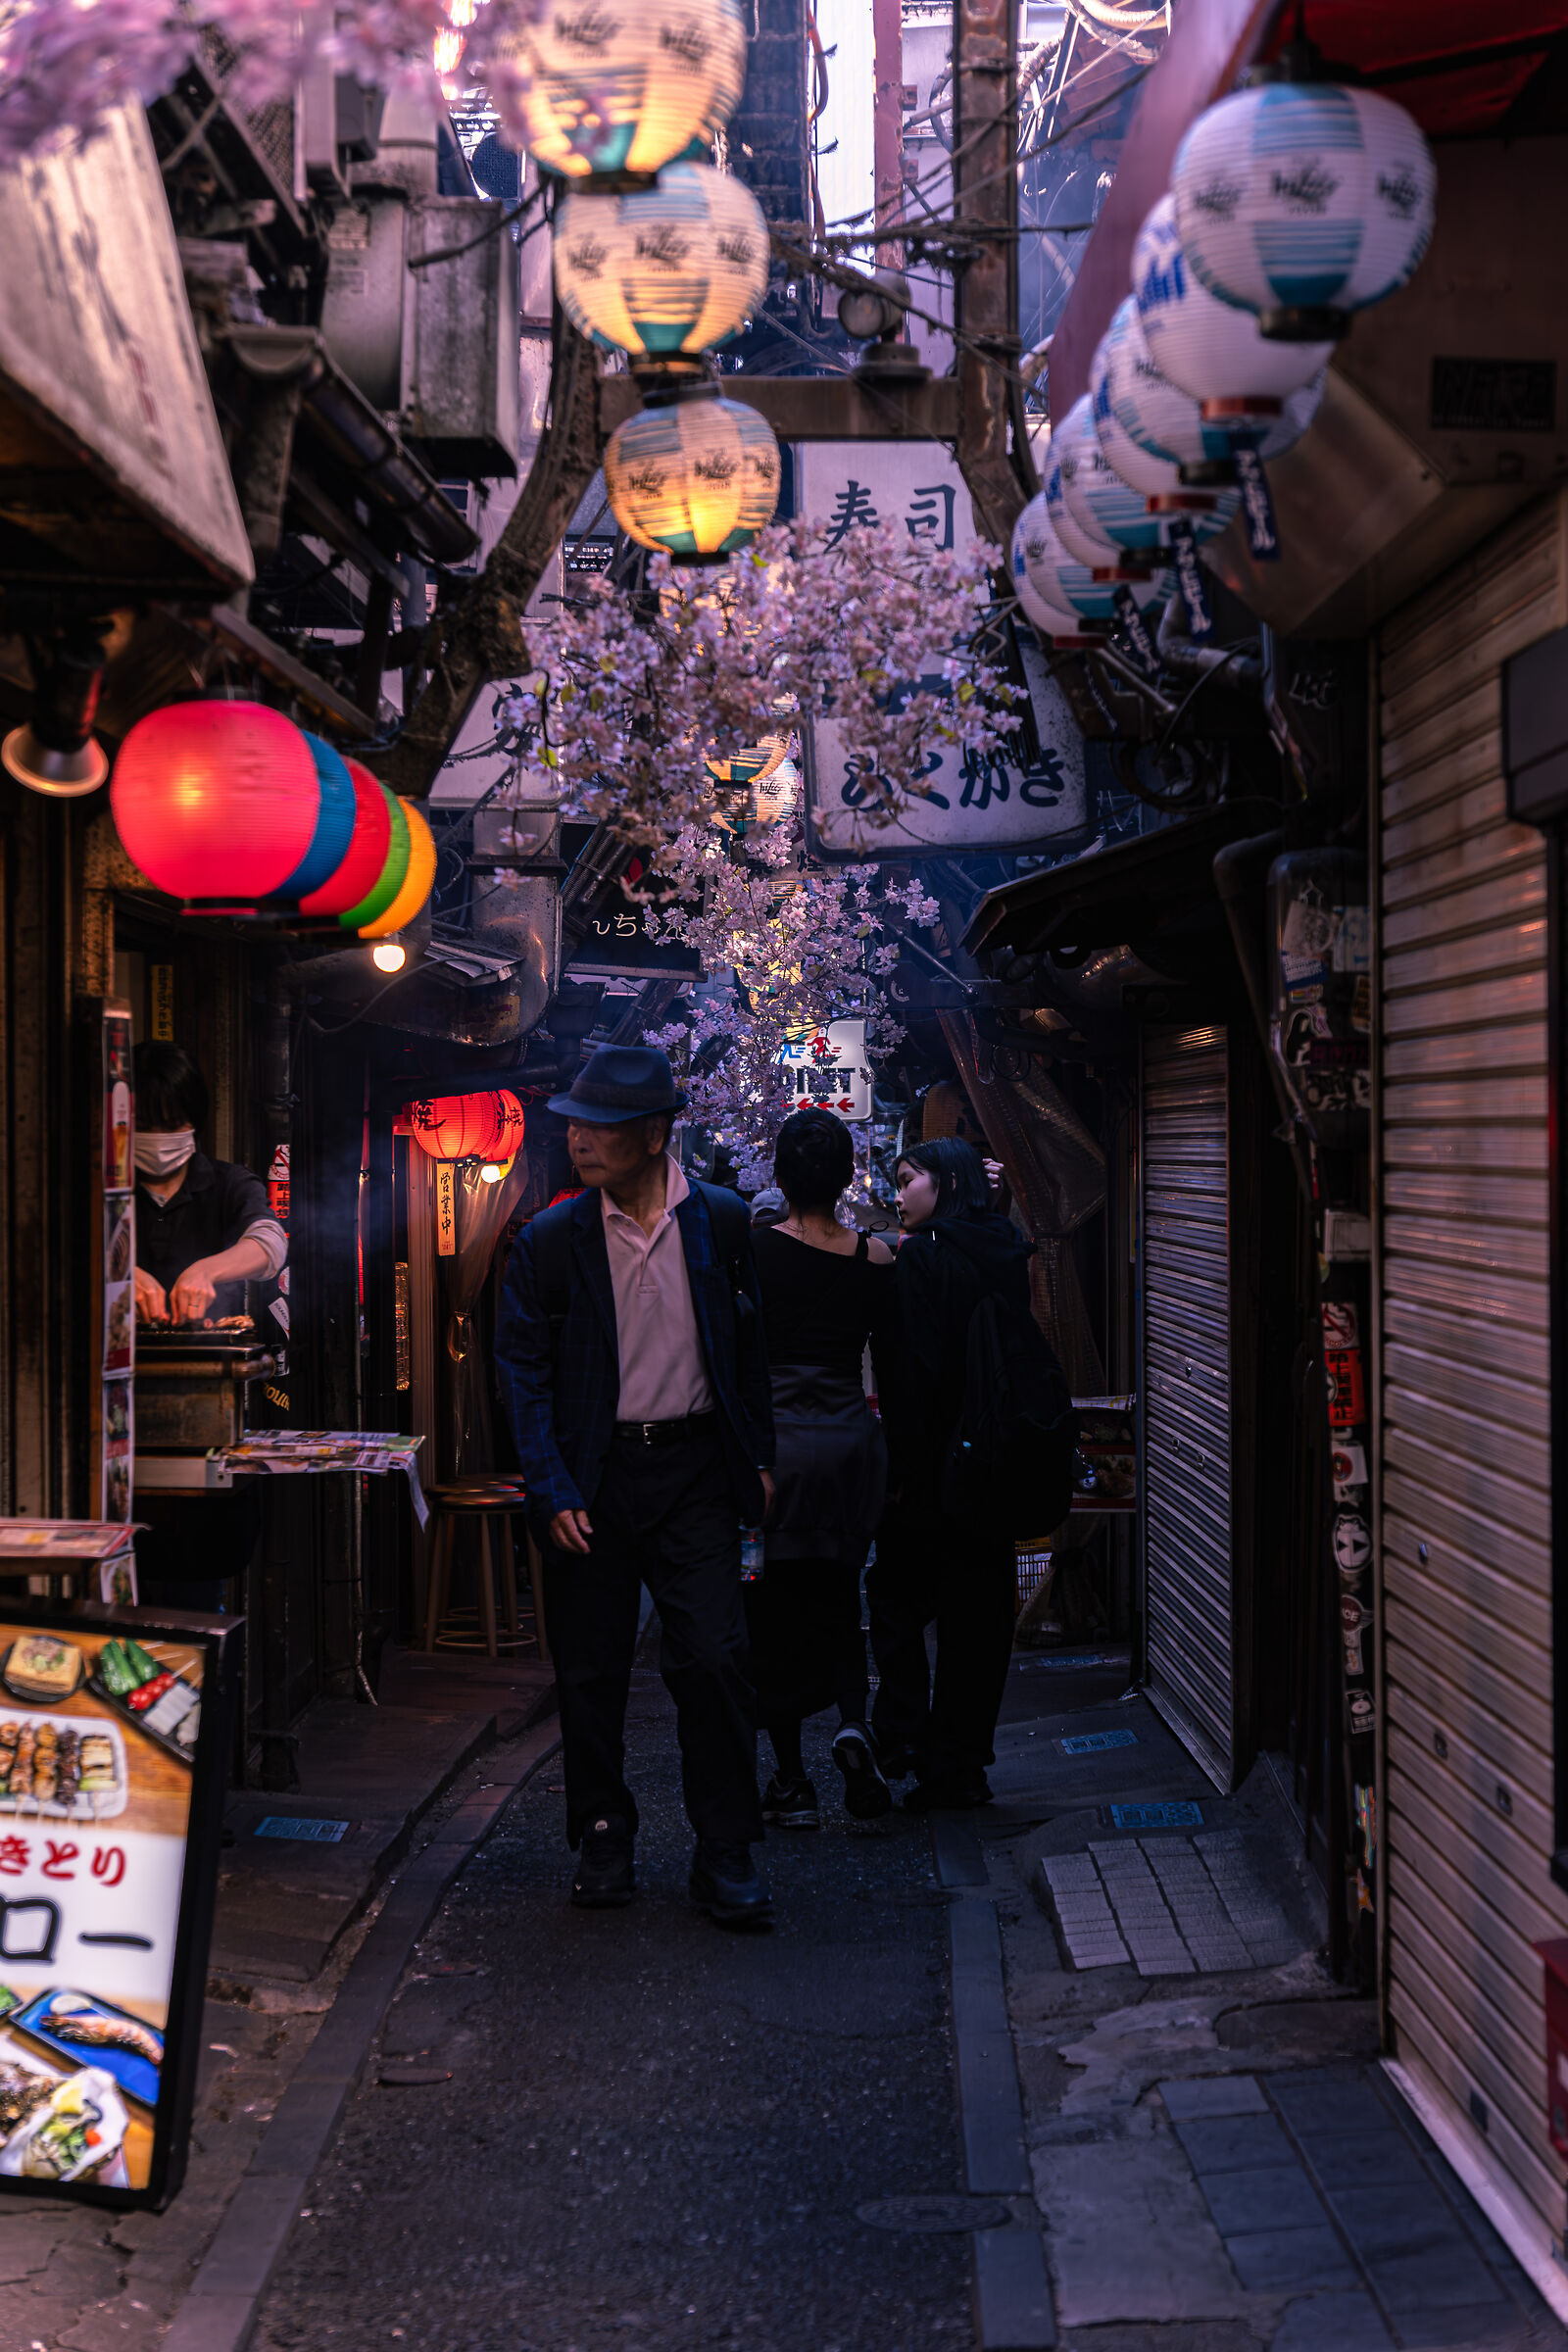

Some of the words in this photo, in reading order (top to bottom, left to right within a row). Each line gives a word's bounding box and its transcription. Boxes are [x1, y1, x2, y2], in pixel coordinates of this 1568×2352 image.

[823, 479, 957, 555] 寿司
[439, 1172, 453, 1236] 営業中
[0, 1834, 126, 1887] きとり
